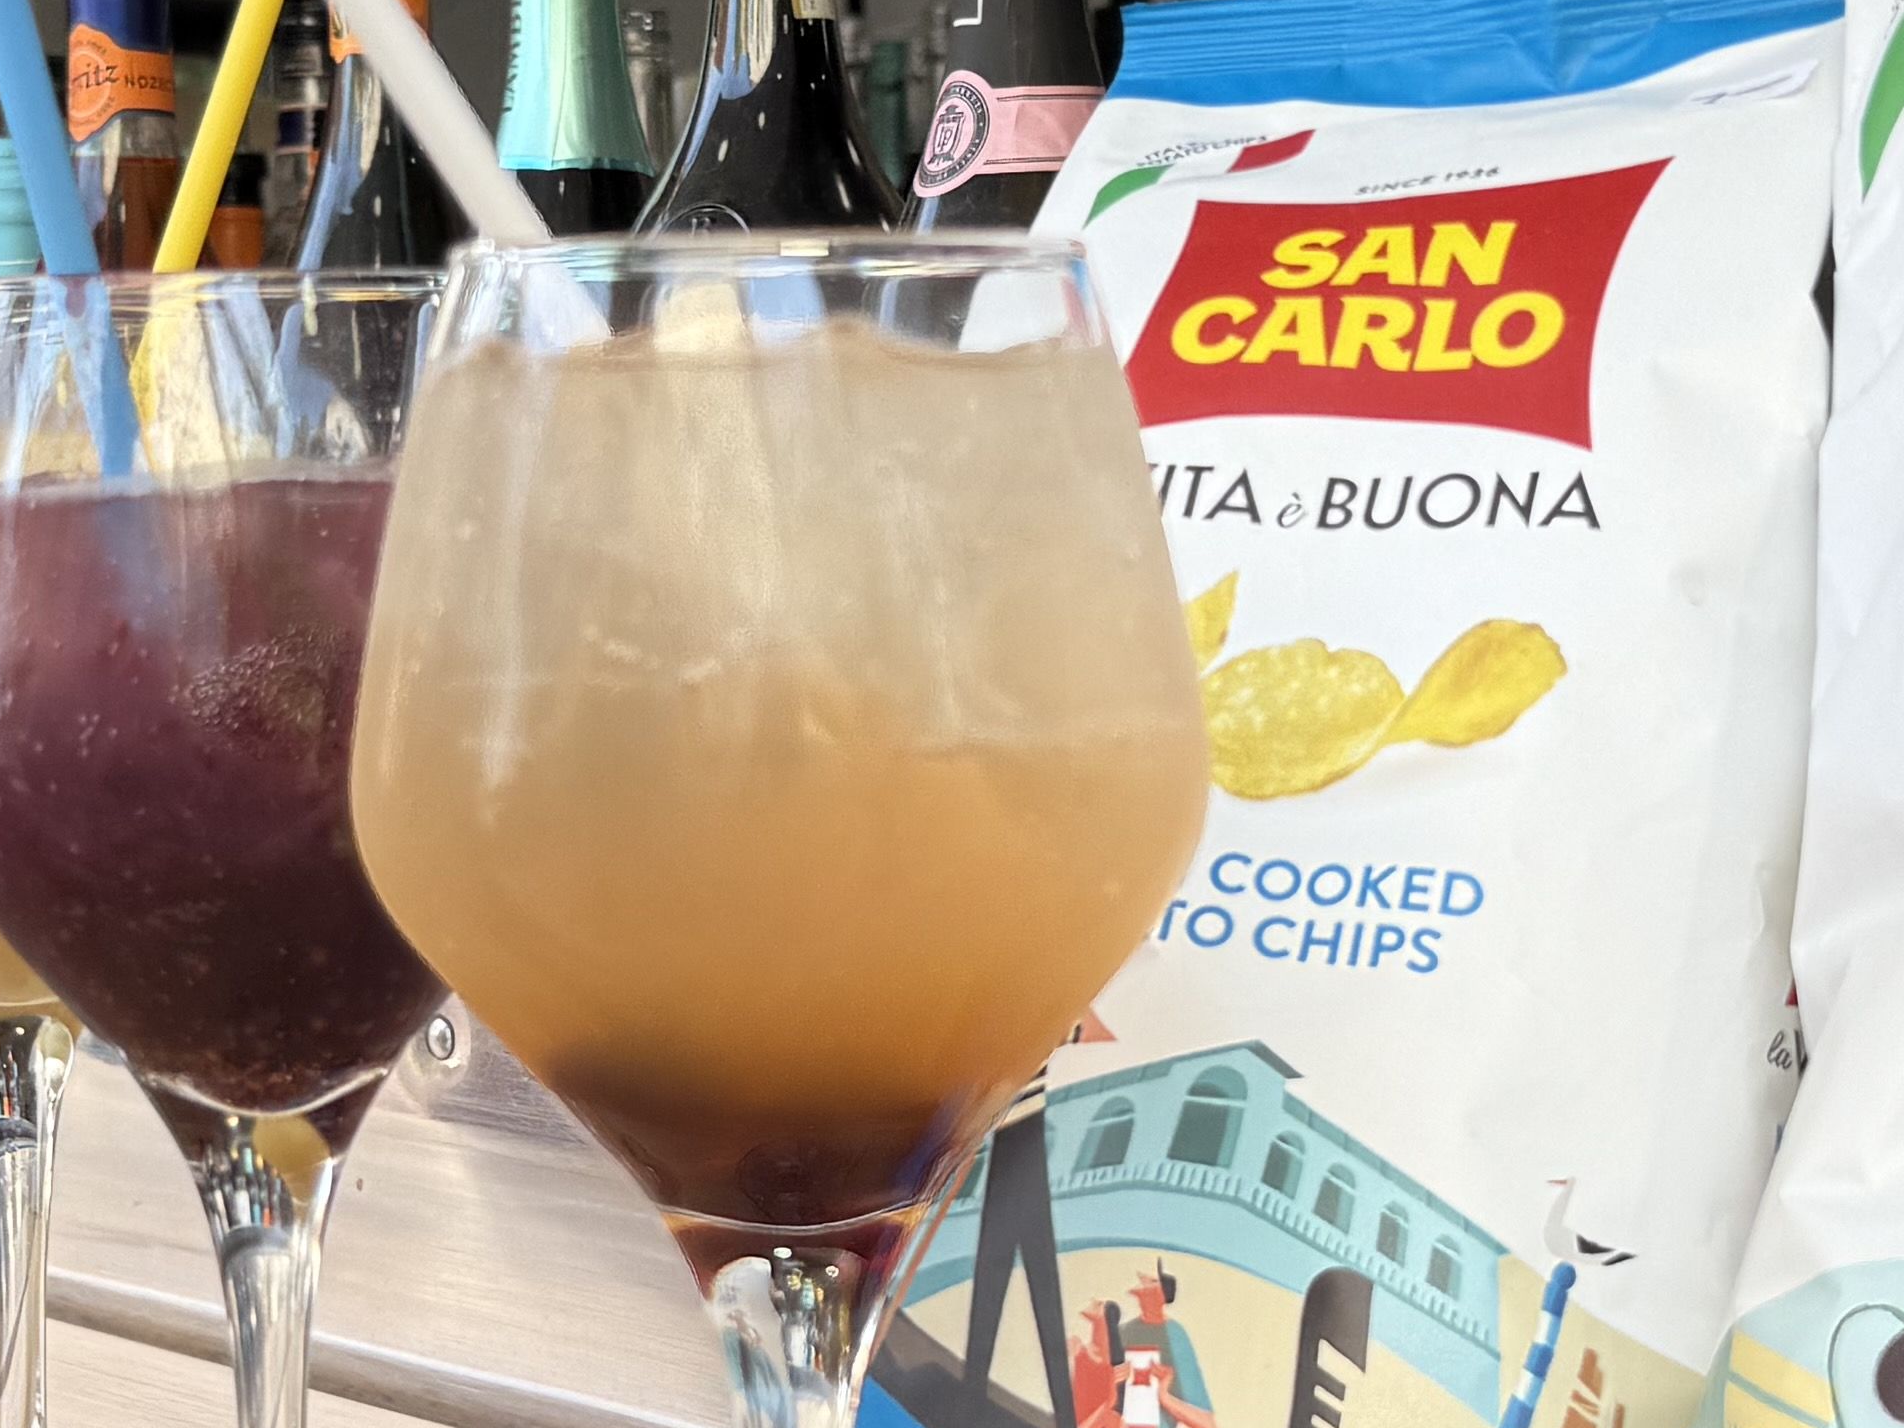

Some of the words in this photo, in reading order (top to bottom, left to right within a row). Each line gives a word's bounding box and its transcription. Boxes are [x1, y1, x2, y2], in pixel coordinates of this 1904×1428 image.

[1355, 174, 1437, 196] SINCE
[1260, 220, 1518, 289] SAN
[1170, 290, 1566, 372] CARLO
[1276, 492, 1307, 528] è
[1315, 470, 1603, 532] BUONA
[1209, 851, 1485, 917] COOKED
[1252, 914, 1443, 974] CHIPS
